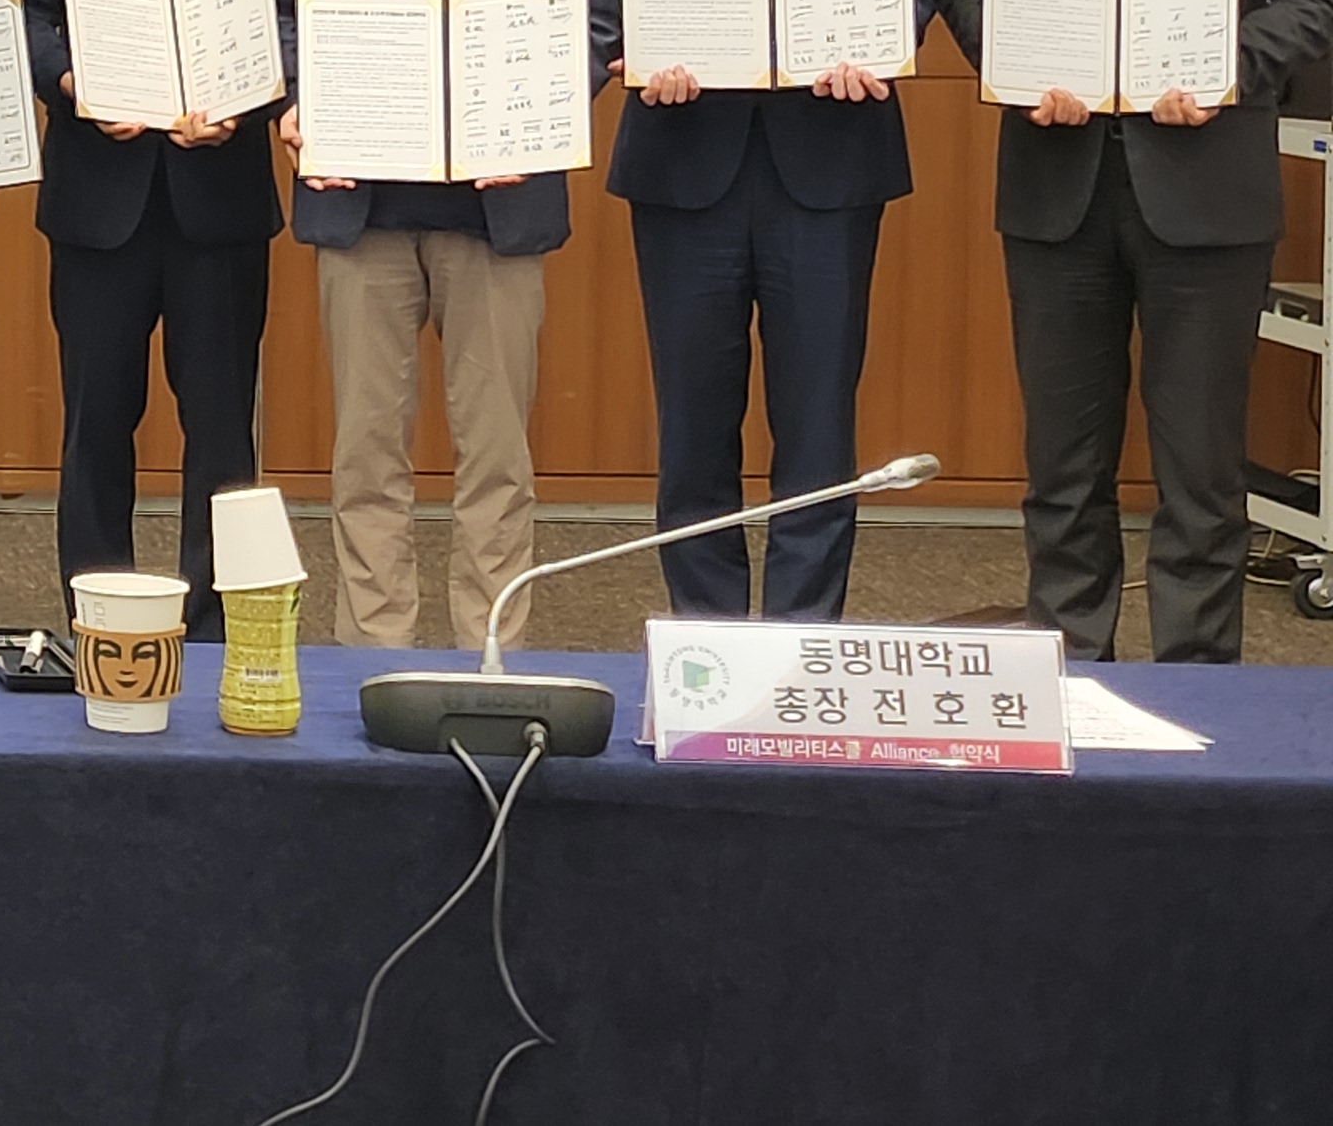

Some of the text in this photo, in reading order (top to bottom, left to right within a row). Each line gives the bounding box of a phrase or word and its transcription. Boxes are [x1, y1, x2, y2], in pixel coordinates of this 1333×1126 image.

[798, 637, 995, 678] 동명대학교
[772, 685, 850, 726] 총장
[725, 737, 862, 761] 미래모빌리티스쿨
